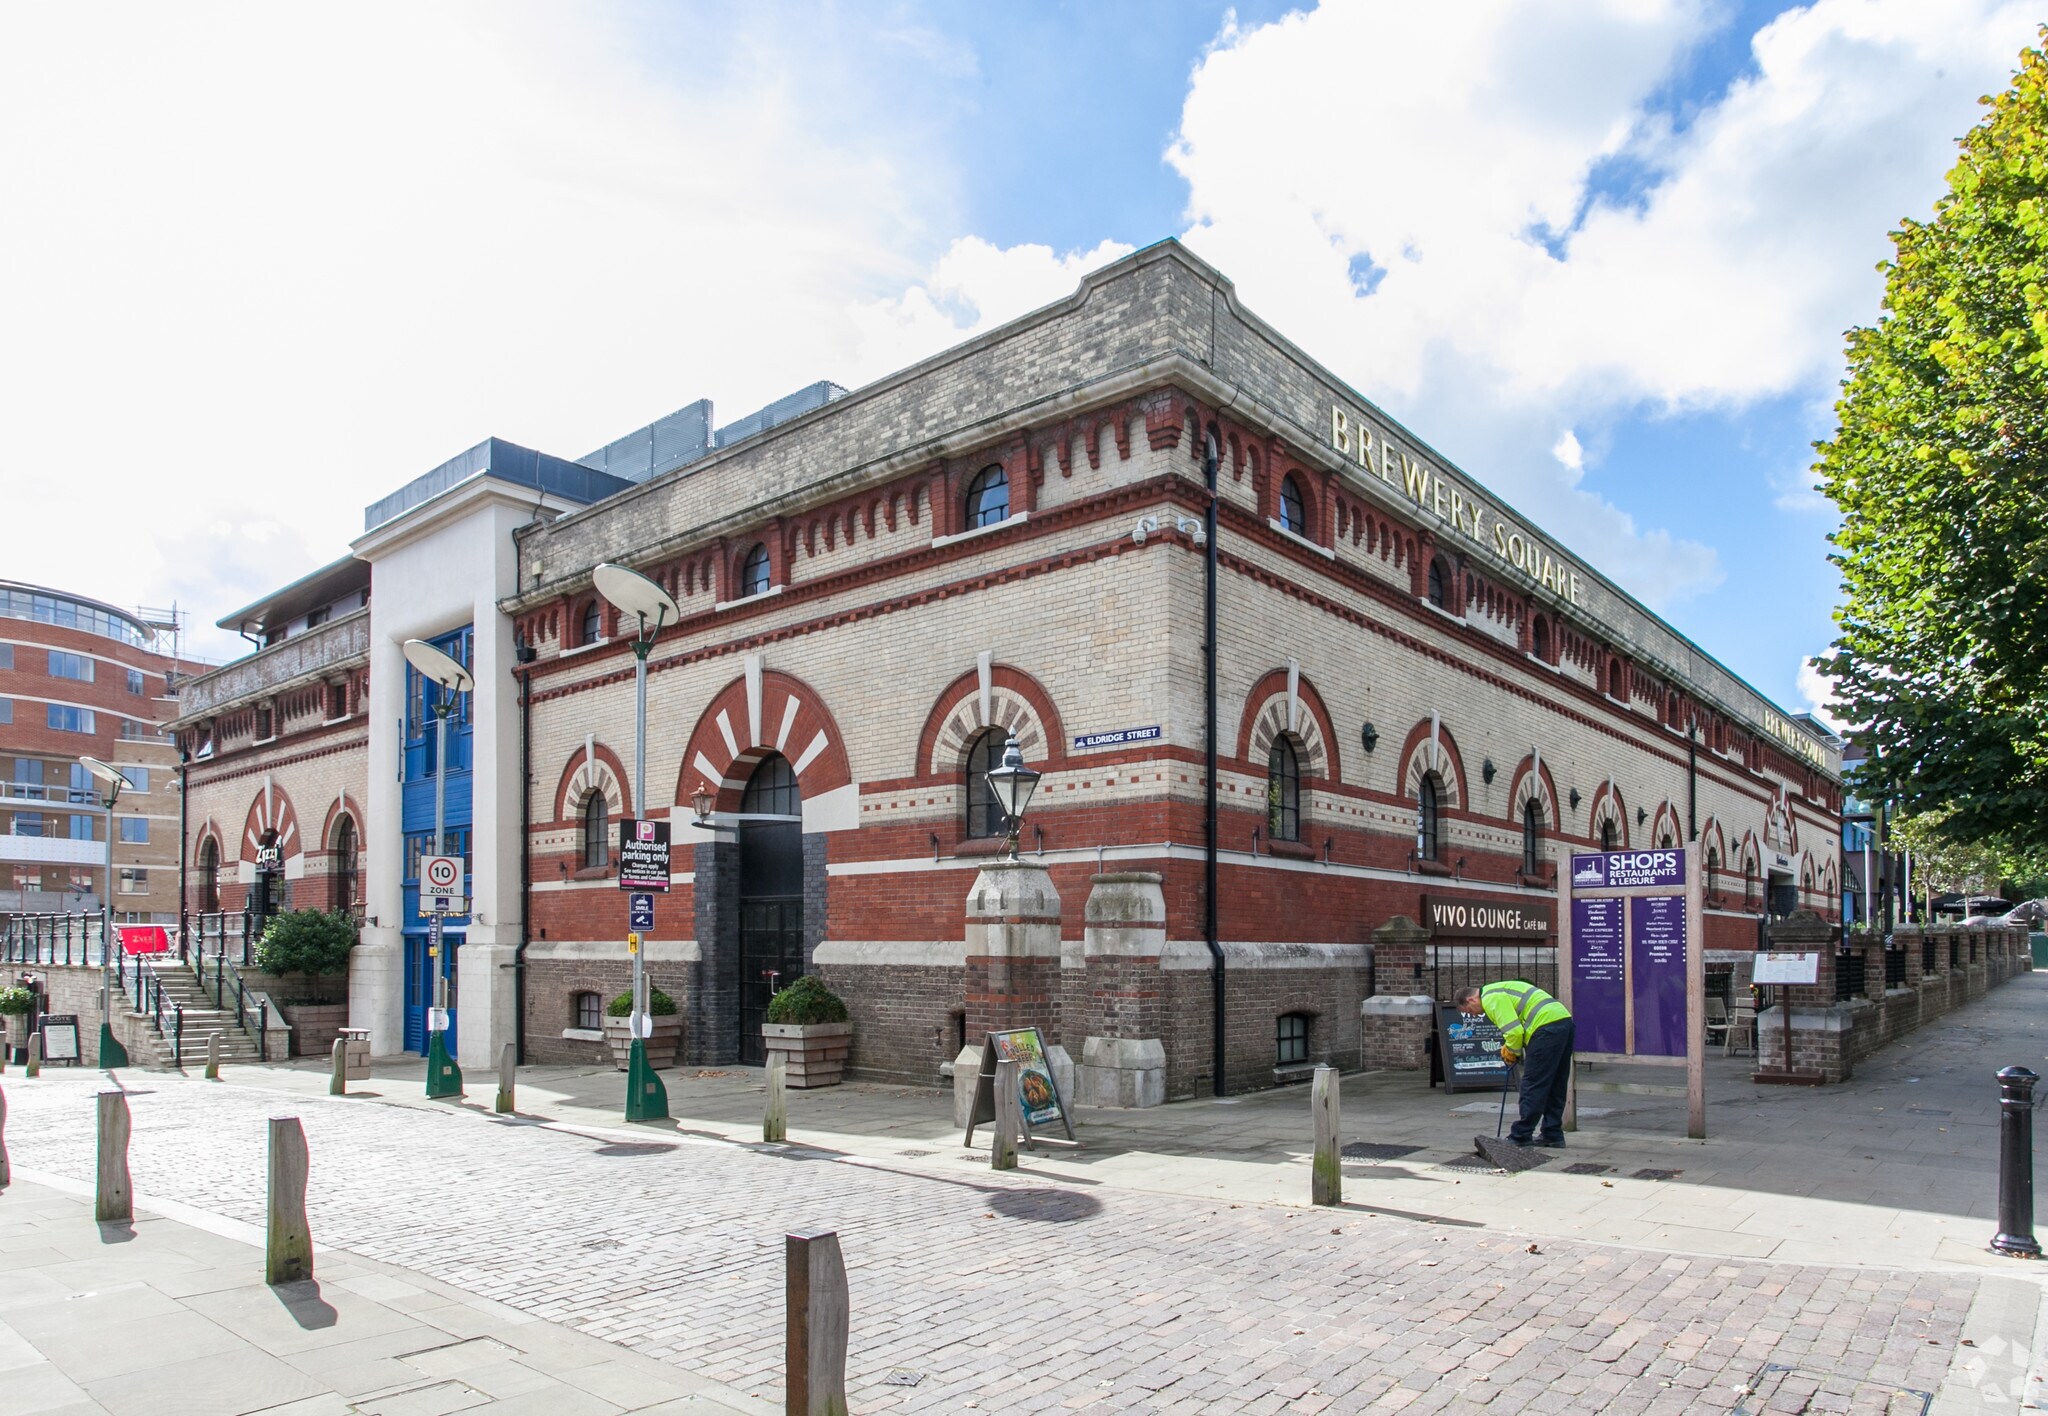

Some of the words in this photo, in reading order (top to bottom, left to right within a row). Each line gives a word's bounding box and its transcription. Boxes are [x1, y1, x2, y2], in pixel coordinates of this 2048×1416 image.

[1332, 405, 1483, 540] BREWERY
[1494, 523, 1580, 606] SQUARE
[1087, 733, 1124, 745] ELDRIDGE
[1127, 728, 1158, 740] STREET
[625, 840, 667, 852] Authorised
[622, 850, 651, 863] parking
[652, 852, 669, 864] only
[1610, 852, 1676, 870] SHOPS
[434, 867, 450, 878] 10
[1610, 868, 1677, 878] RESTAURANTS
[1618, 877, 1656, 885] LEISURE
[1433, 904, 1466, 928] VIVO
[1471, 907, 1521, 929] LOUNGE
[1523, 919, 1536, 930] CAFÉ
[1537, 921, 1547, 930] BAR
[630, 936, 637, 951] H
